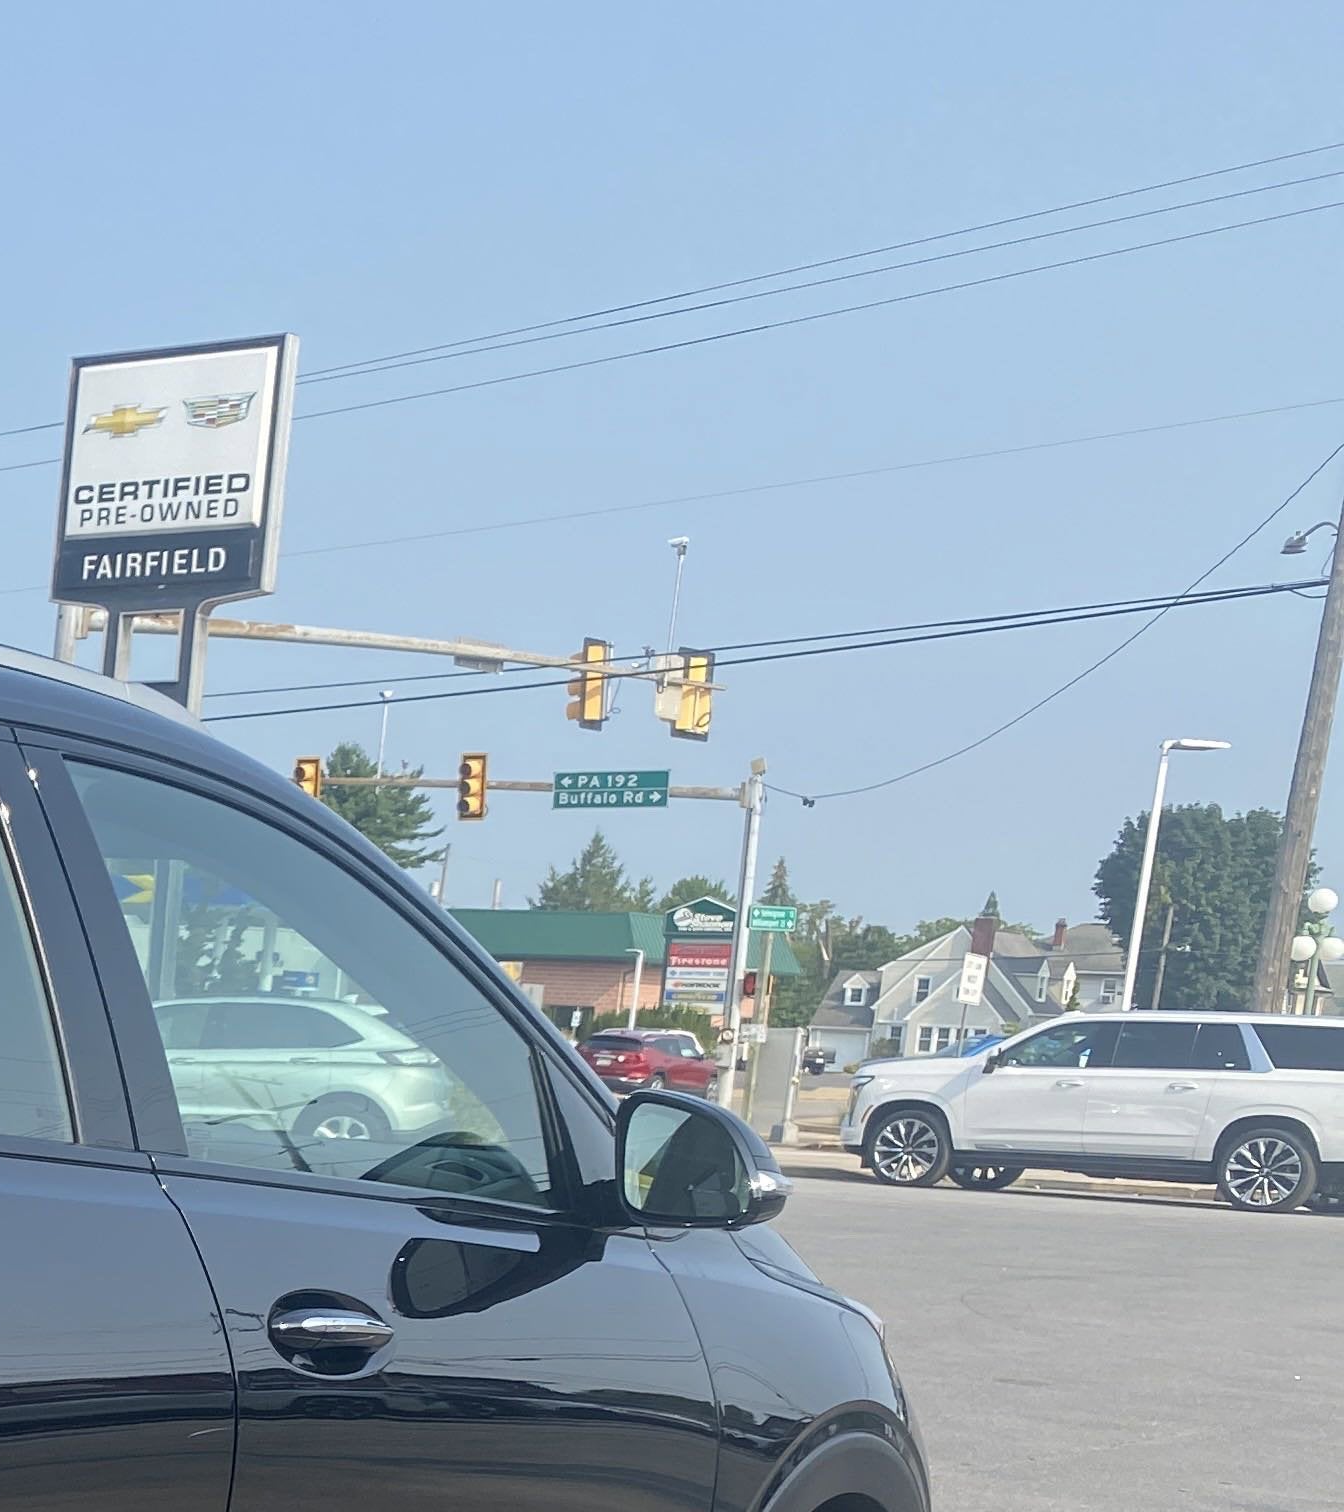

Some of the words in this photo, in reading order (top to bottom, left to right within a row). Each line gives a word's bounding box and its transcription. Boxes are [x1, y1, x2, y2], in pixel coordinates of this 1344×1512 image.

[73, 472, 251, 505] CERTIFIED
[79, 498, 239, 527] PRE-OWNED
[81, 546, 227, 581] FAIRFIELD
[577, 775, 601, 788] PA
[607, 774, 639, 788] 192
[558, 791, 618, 805] Buffalo
[623, 791, 644, 803] Rd
